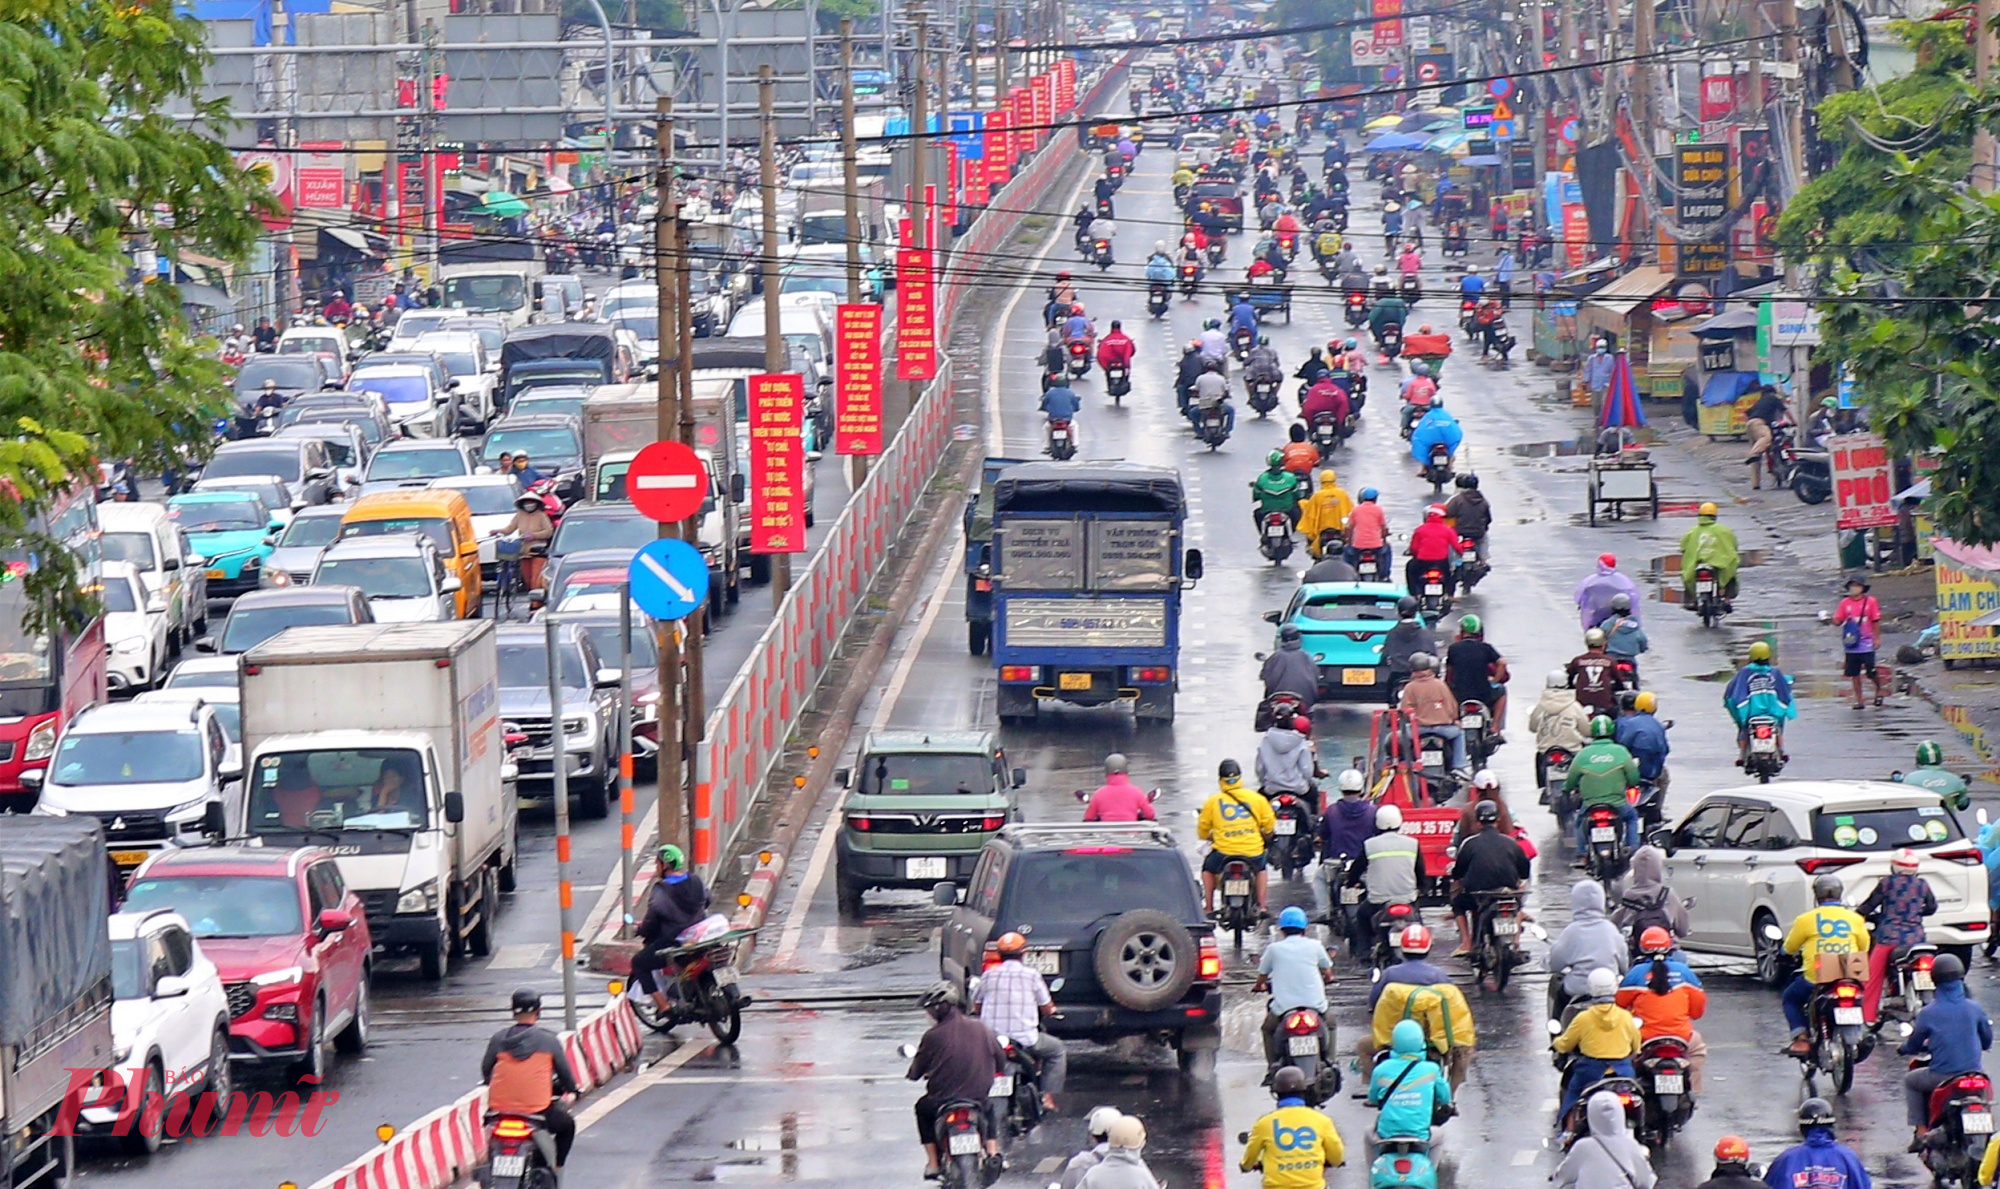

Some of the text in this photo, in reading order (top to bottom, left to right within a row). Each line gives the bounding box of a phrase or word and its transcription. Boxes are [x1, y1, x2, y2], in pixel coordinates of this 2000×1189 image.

[1683, 205, 1724, 218] LAPTOP
[1937, 588, 1971, 612] LÀM
[1590, 753, 1615, 764] Grab
[1922, 778, 1947, 788] Grab
[1218, 798, 1254, 821] be
[1398, 821, 1421, 834] 908
[1423, 821, 1437, 834] 35
[1816, 912, 1851, 938] be
[1816, 938, 1851, 953] Food
[1273, 1118, 1317, 1151] be
